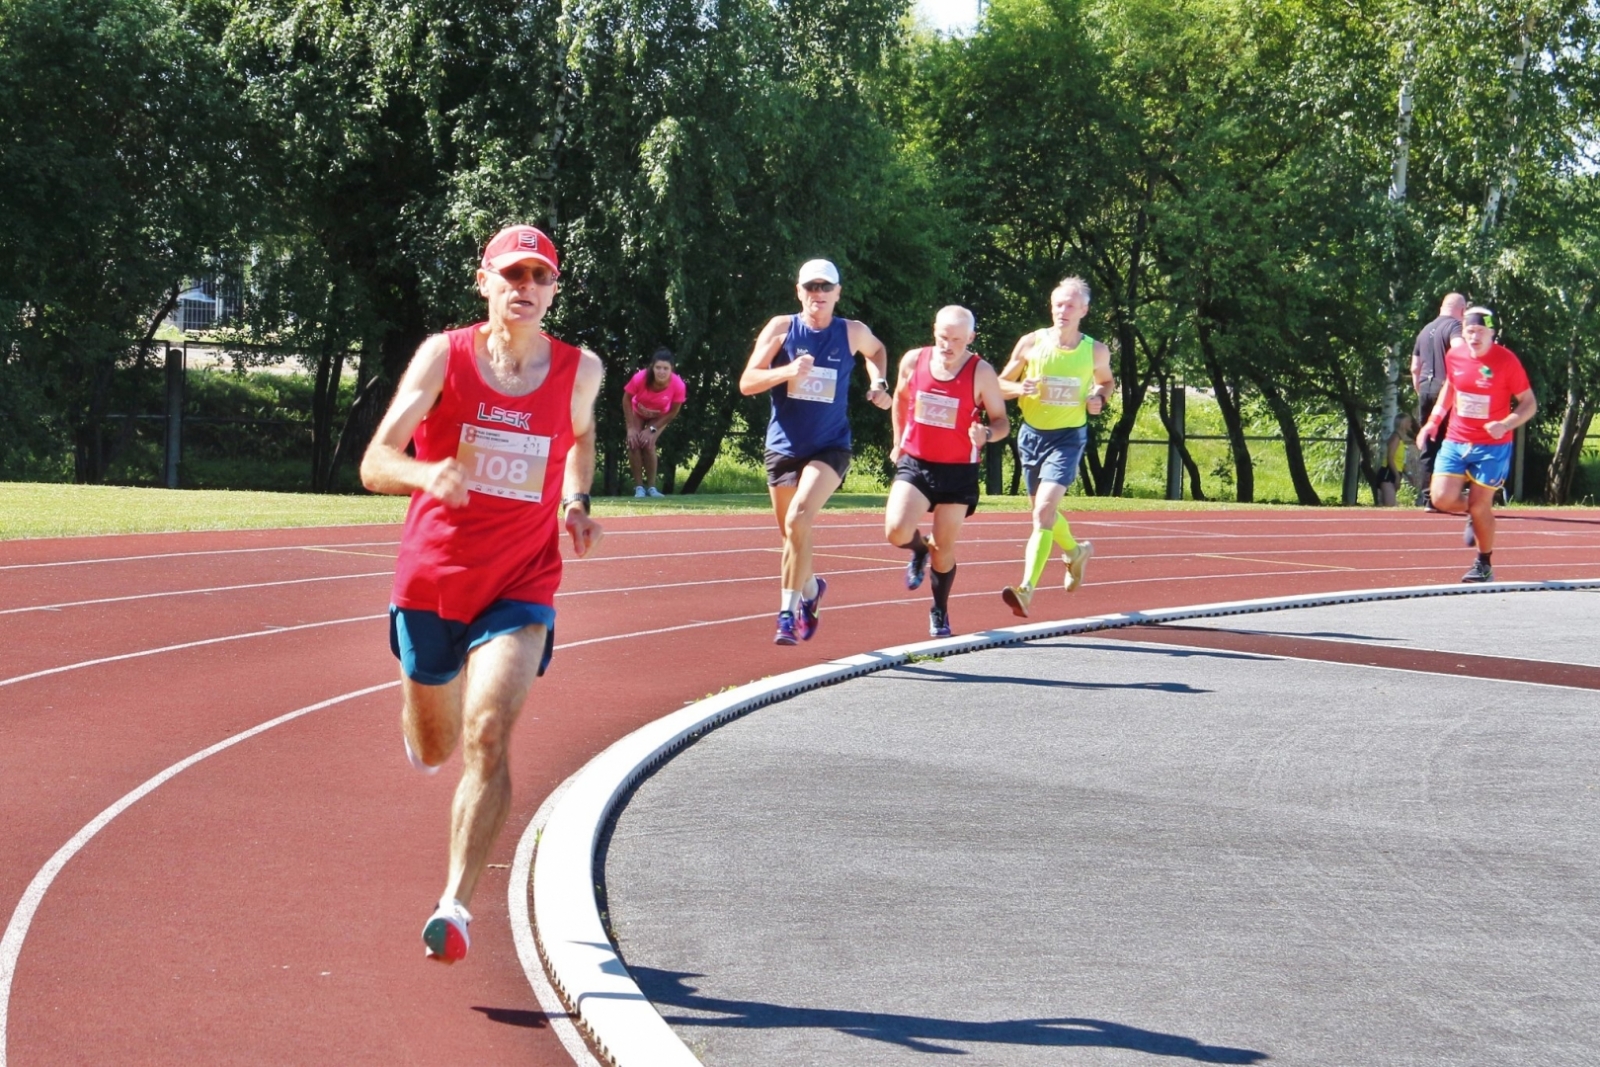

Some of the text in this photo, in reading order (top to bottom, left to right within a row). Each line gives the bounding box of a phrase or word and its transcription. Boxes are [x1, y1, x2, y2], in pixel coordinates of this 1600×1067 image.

[800, 379, 824, 393] 40
[1047, 387, 1073, 399] 174
[477, 402, 532, 431] LSSK
[921, 404, 949, 420] 144
[474, 452, 529, 485] 108
